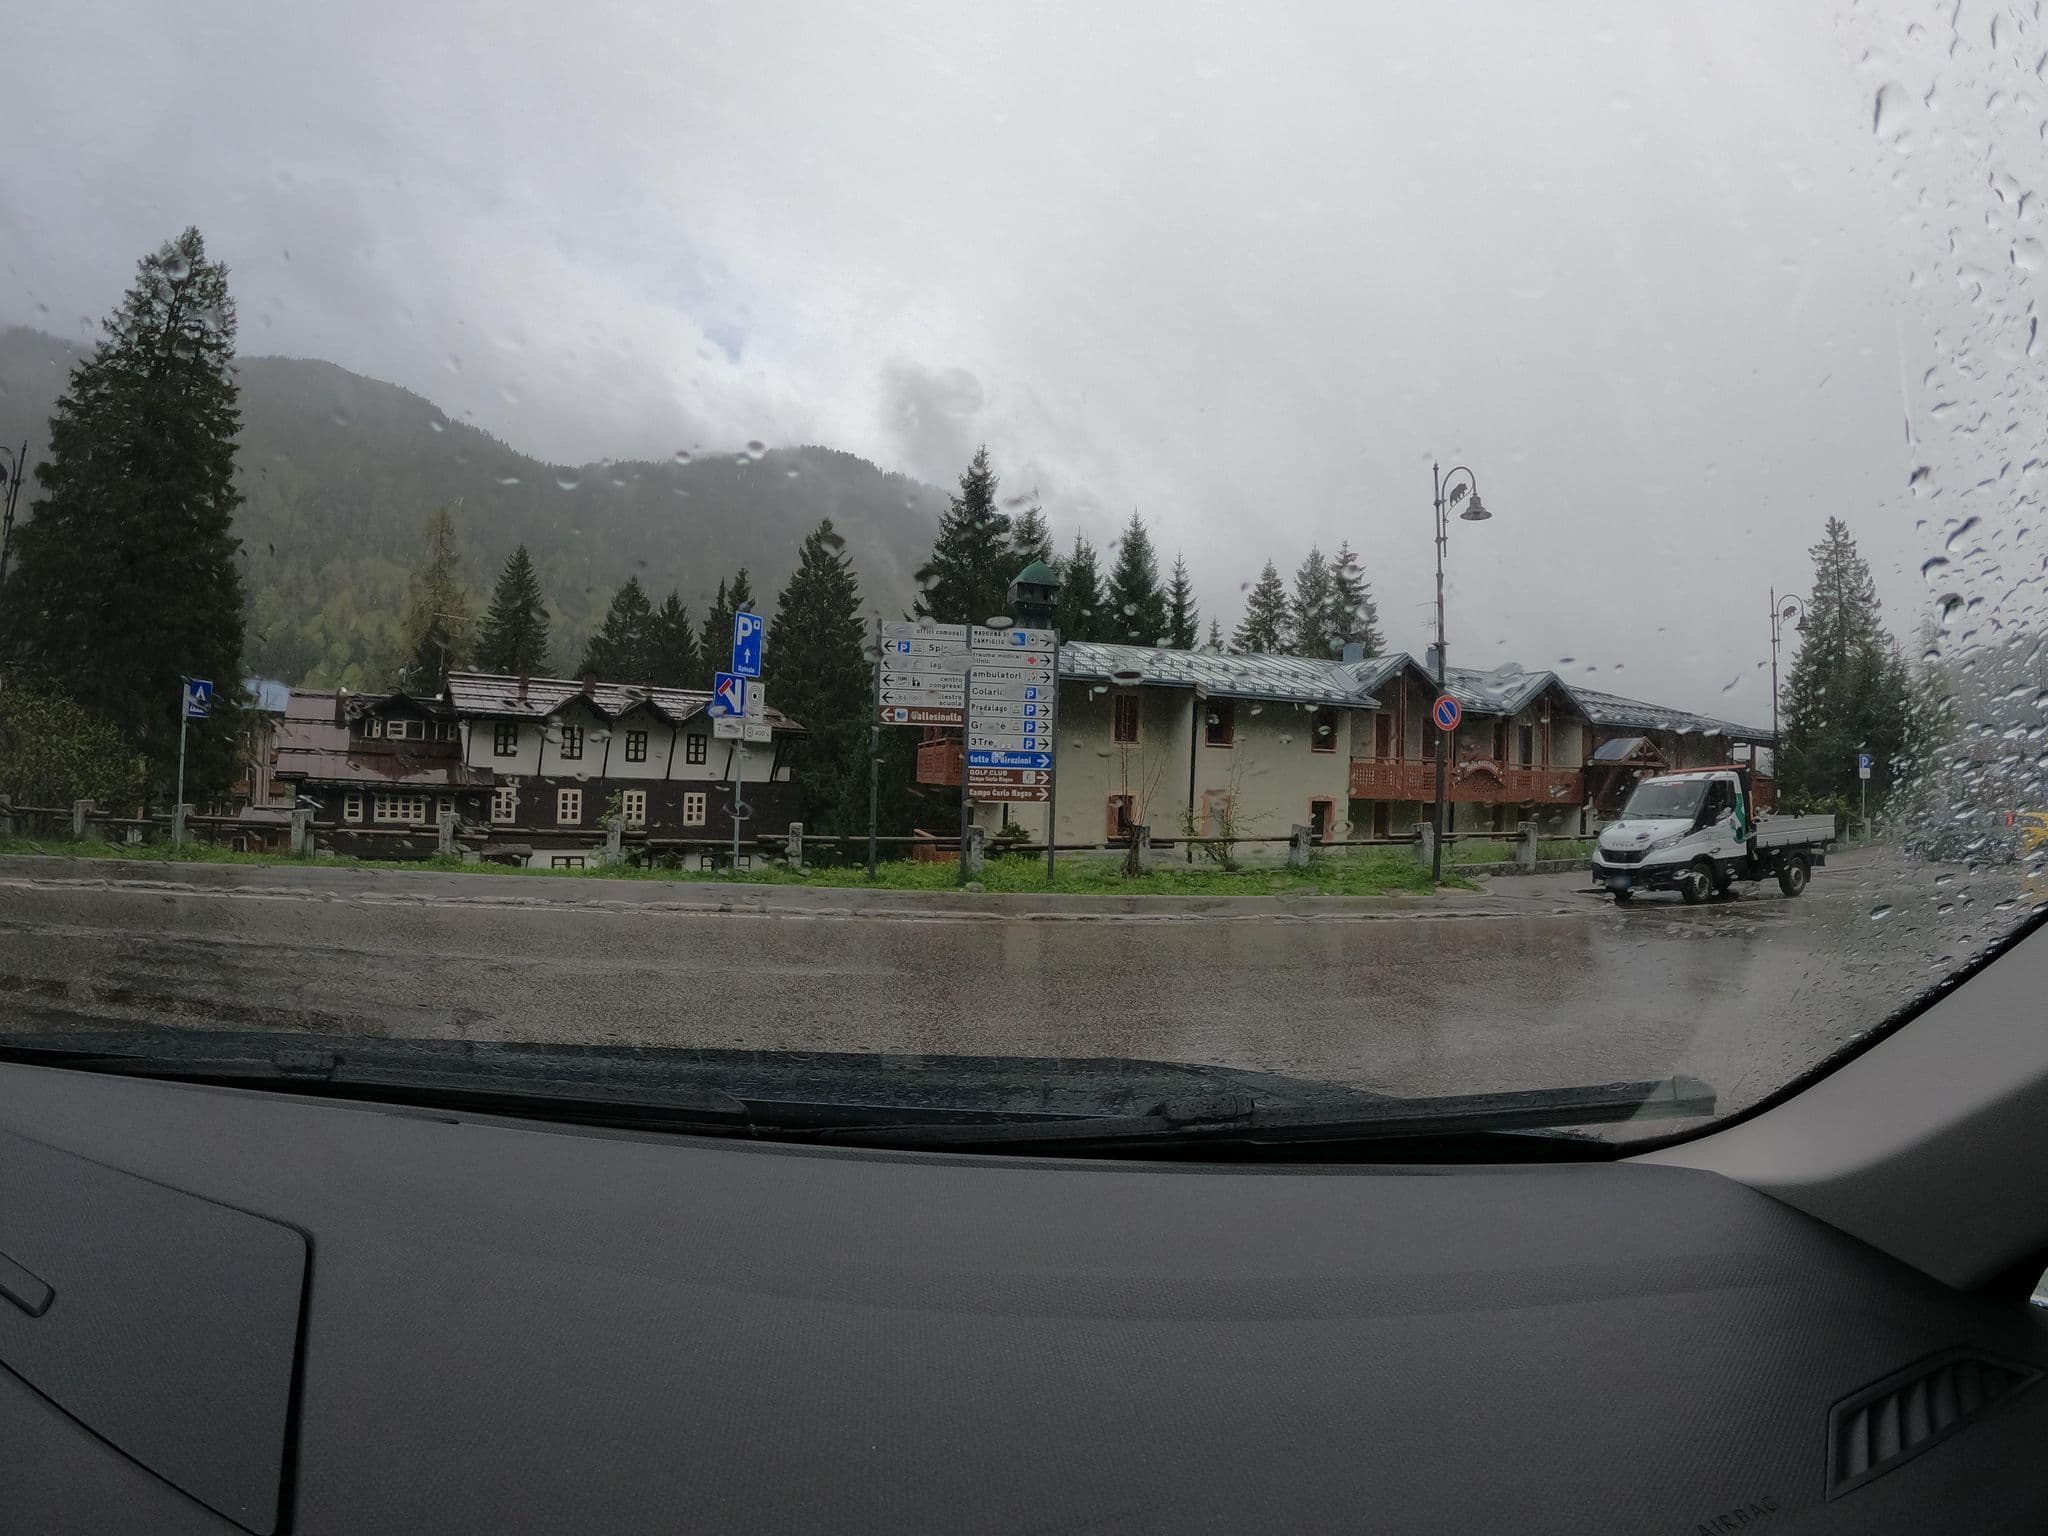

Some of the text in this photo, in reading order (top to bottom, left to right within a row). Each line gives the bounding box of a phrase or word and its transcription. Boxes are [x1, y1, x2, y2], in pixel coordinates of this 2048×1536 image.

[737, 616, 752, 645] P
[972, 671, 1021, 679] ambulatori
[929, 682, 964, 690] congressi
[972, 687, 1004, 696] Colari
[971, 703, 1008, 713] Pradalago
[969, 788, 1032, 798] Campo Carlo Magno
[1697, 1496, 1777, 1536] AIRBAG
